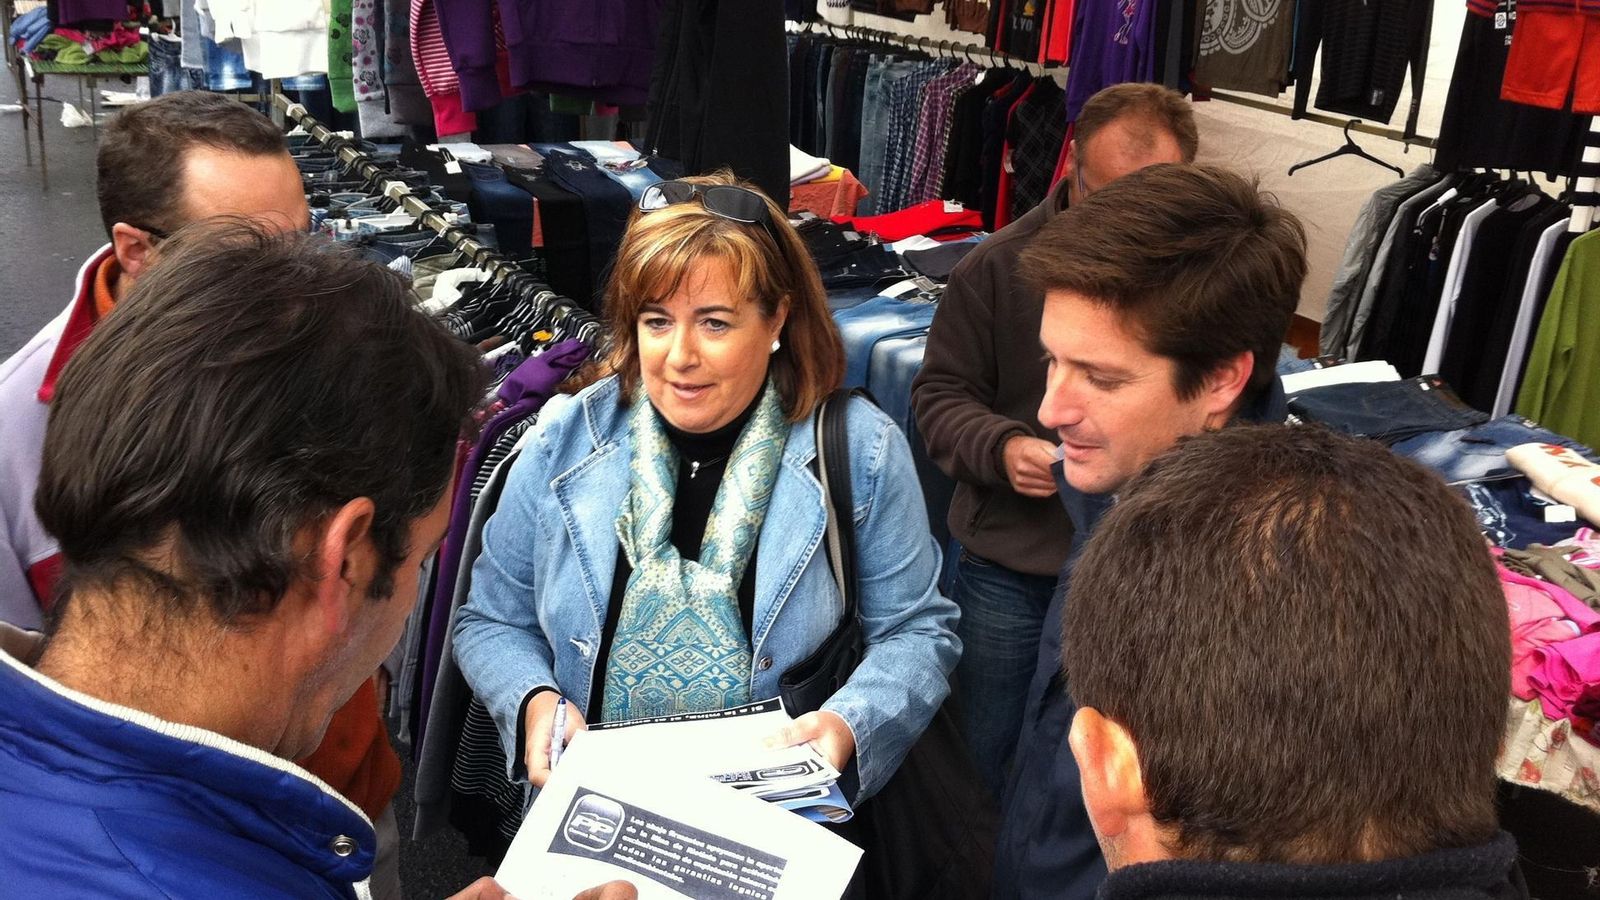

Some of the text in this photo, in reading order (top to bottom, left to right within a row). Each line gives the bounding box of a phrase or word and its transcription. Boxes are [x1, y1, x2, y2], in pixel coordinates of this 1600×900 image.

[570, 814, 615, 833] PP
[617, 843, 646, 858] todas
[651, 855, 668, 866] las
[728, 882, 767, 900] legales
